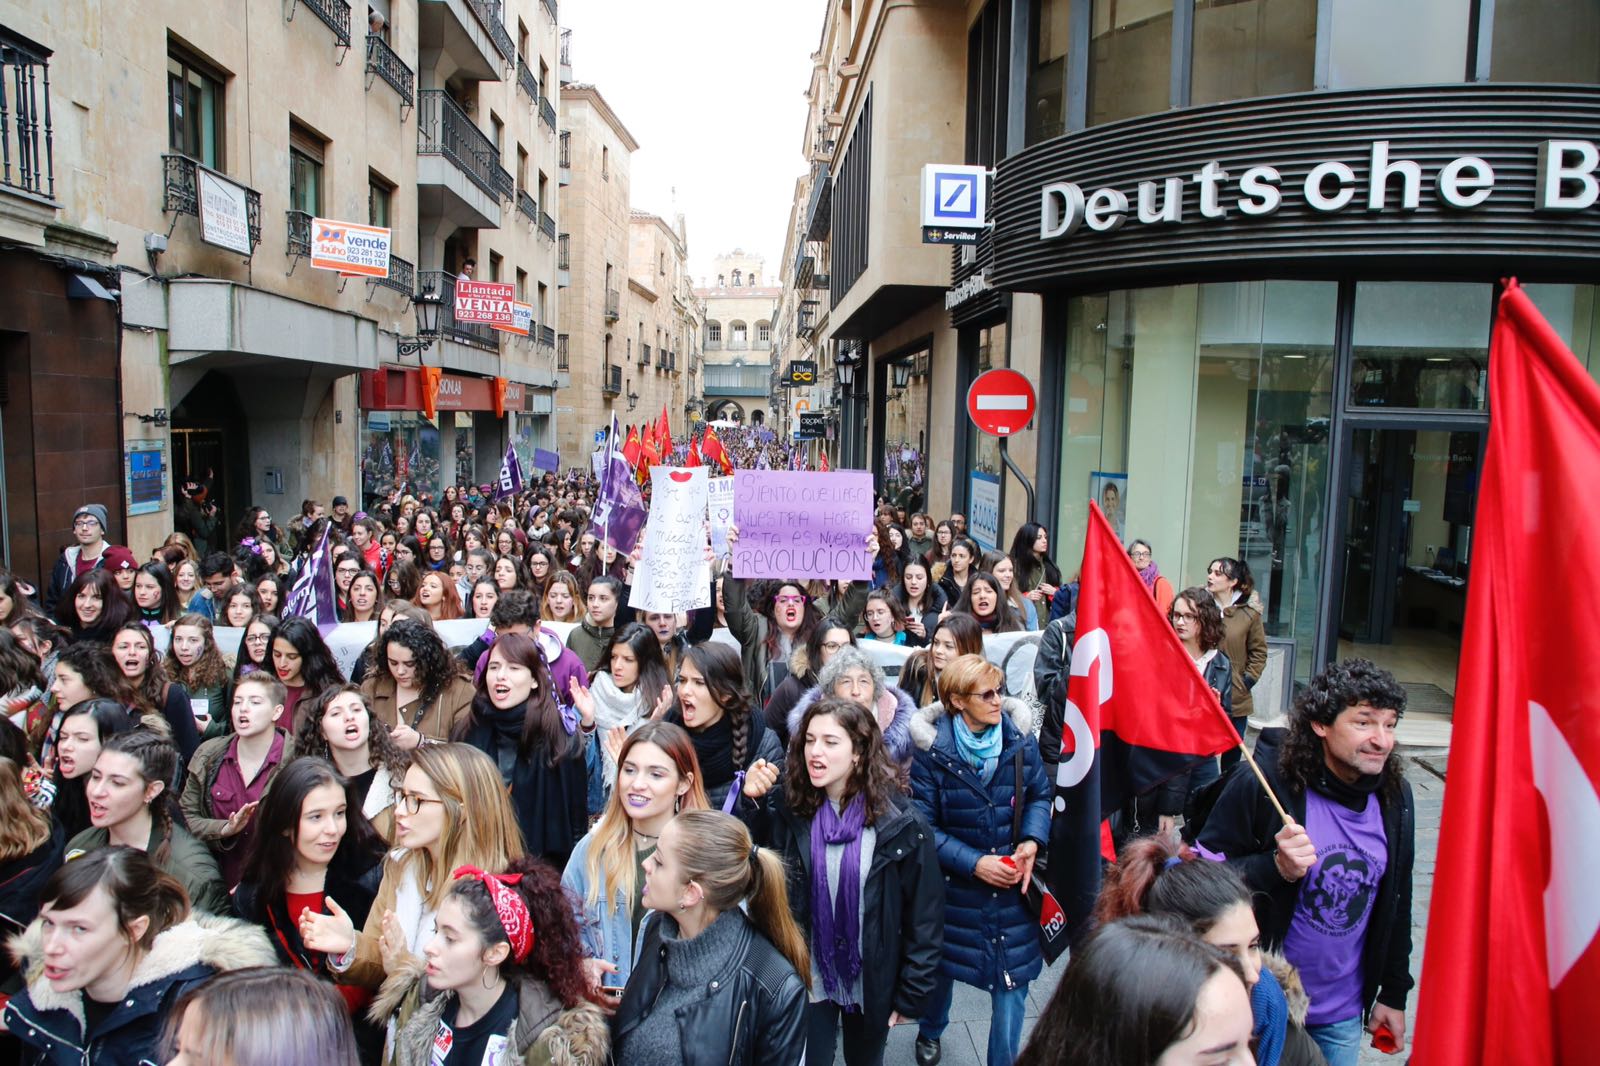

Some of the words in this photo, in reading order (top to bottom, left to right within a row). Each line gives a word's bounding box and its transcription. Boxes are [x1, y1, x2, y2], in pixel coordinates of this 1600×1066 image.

[1040, 140, 1495, 241] Deutsche
[943, 231, 977, 240] ServiRed
[347, 236, 387, 250] vende
[347, 247, 359, 255] 923
[361, 249, 373, 257] 281
[374, 251, 386, 259] 323
[347, 255, 359, 263] 629
[361, 257, 373, 265] 119
[374, 259, 386, 267] 130
[460, 282, 512, 297] Llantada
[459, 299, 511, 313] VENTA
[458, 310, 474, 318] 923
[495, 313, 511, 321] 136
[513, 309, 531, 319] ende
[793, 364, 812, 373] Ulloa
[708, 481, 716, 494] 8
[823, 511, 860, 527] HORA
